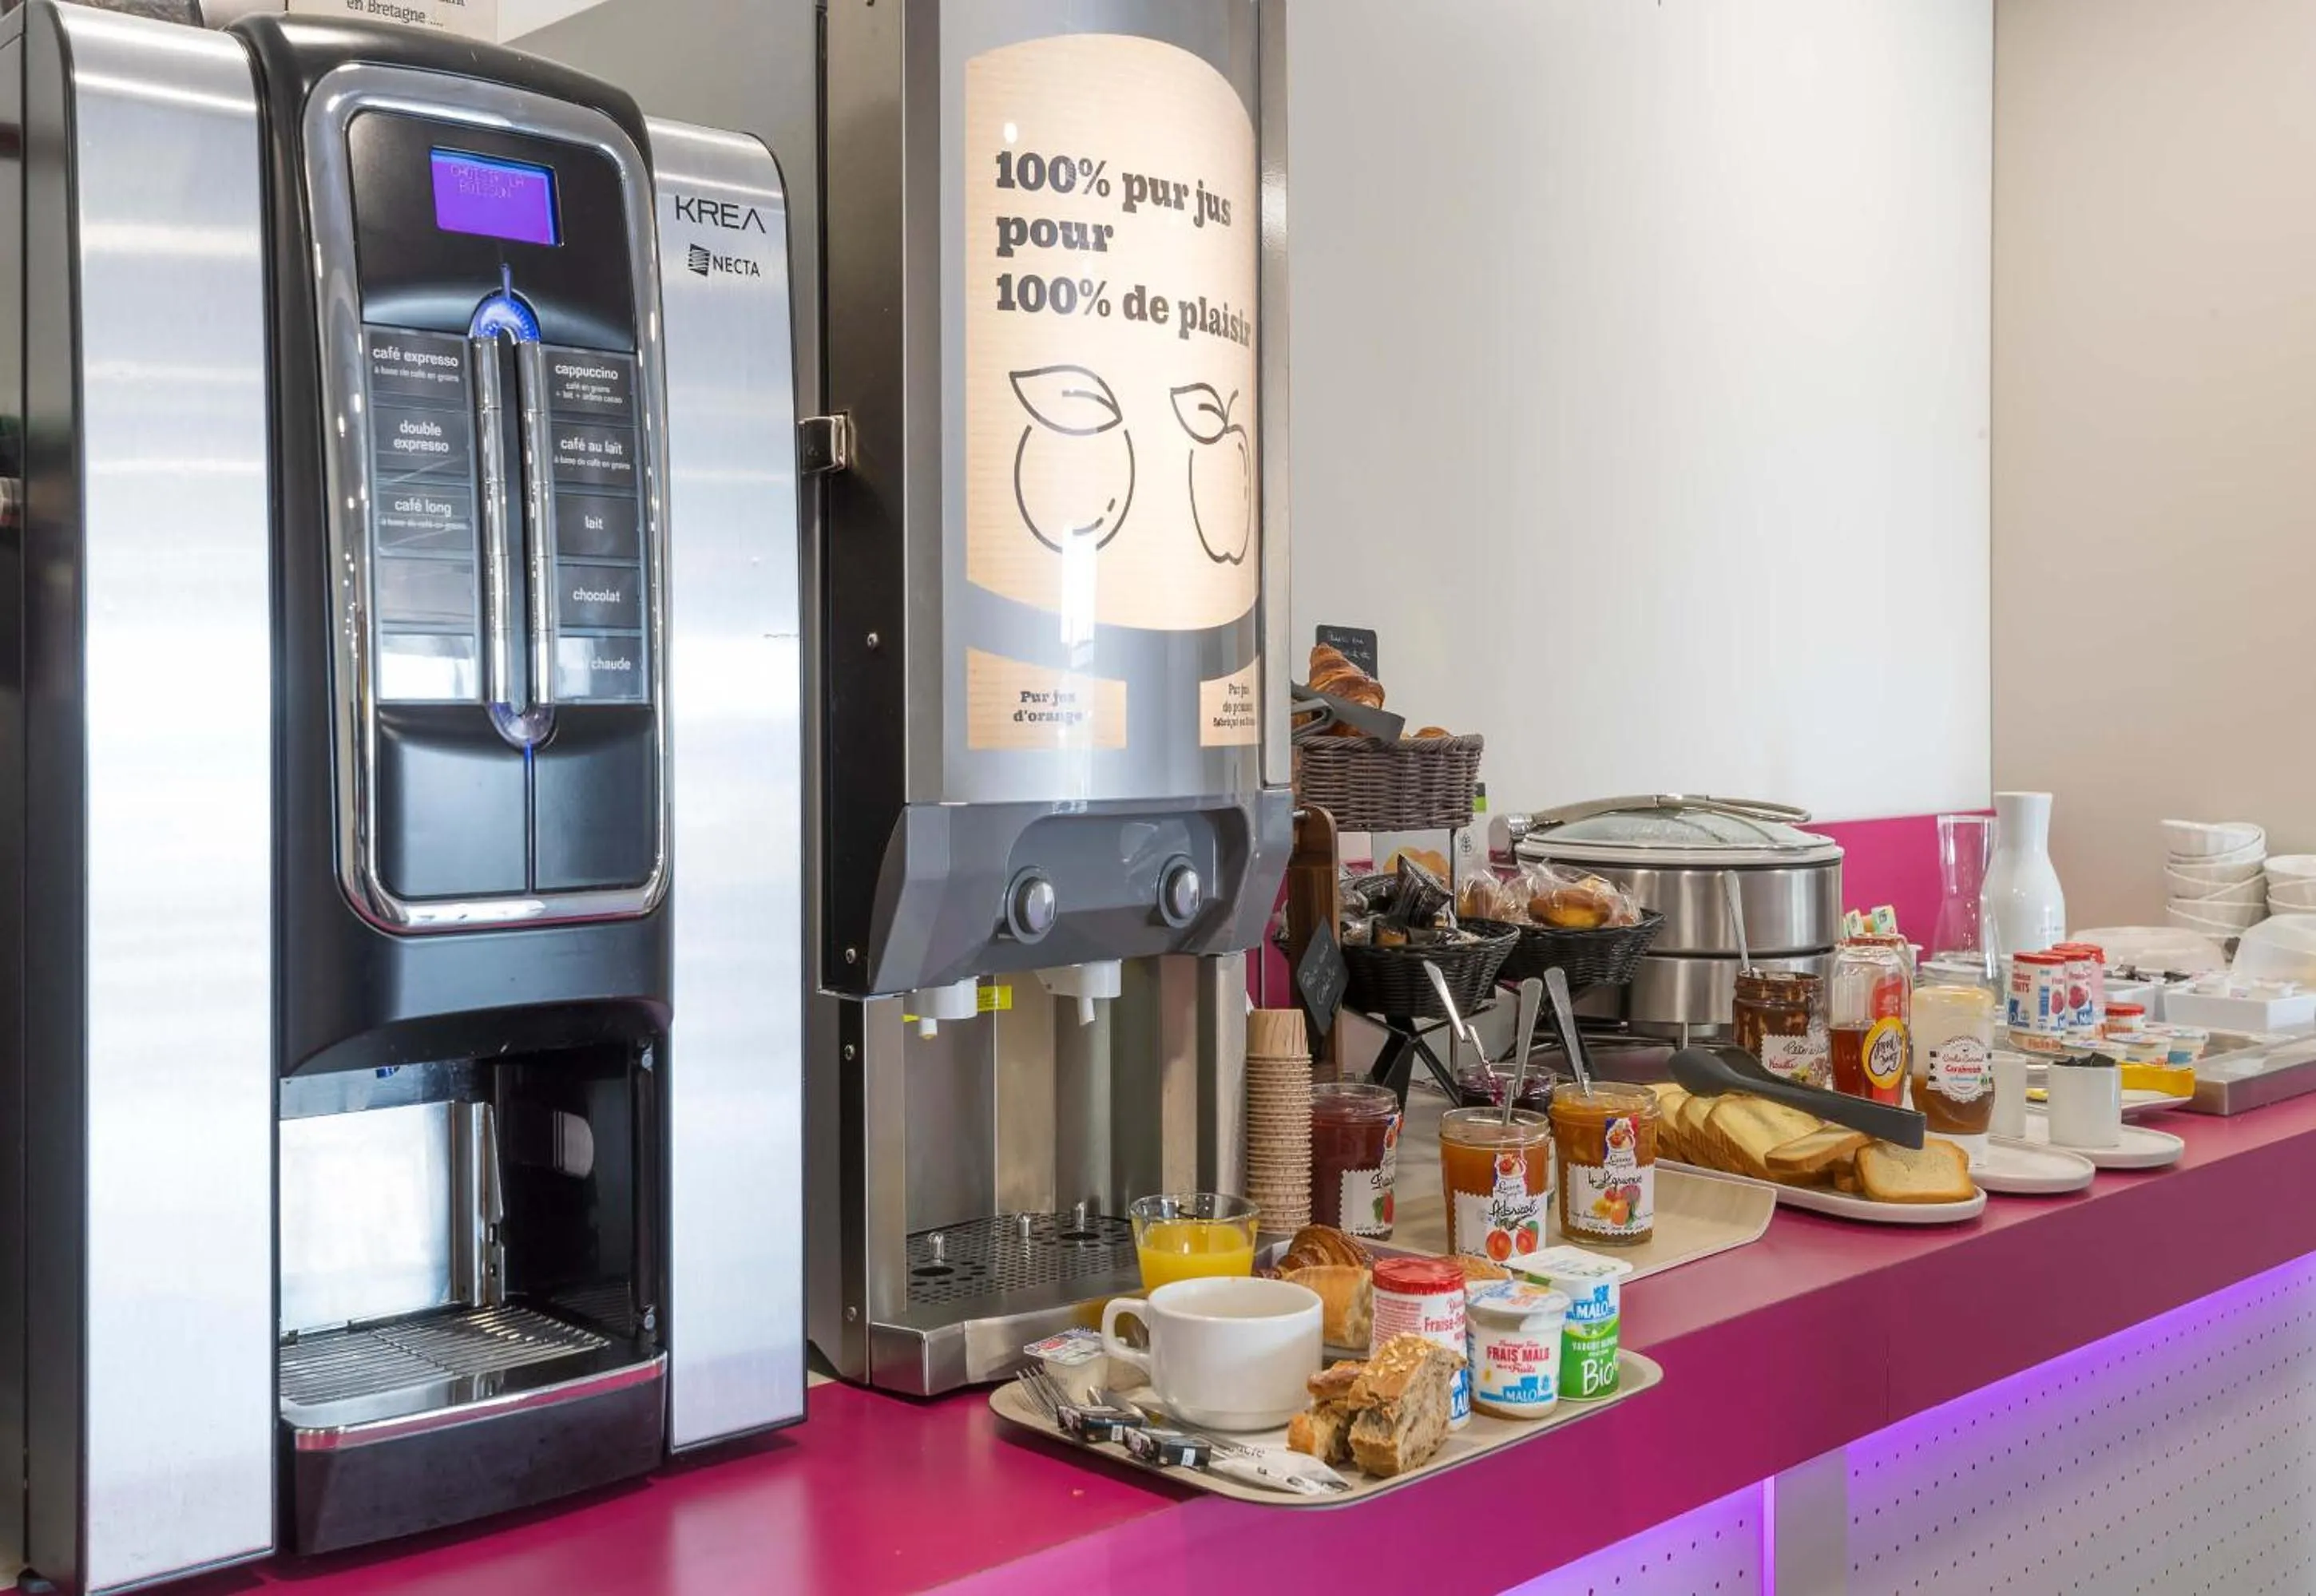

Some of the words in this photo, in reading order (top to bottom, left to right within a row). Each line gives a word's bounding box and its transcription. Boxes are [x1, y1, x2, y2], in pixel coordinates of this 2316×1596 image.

[367, 0, 425, 23] Bretagne
[995, 150, 1111, 198] 100%
[1121, 172, 1190, 214] pur
[1193, 179, 1231, 228] jus
[675, 194, 767, 234] KREA
[996, 216, 1114, 258] pour
[712, 255, 761, 278] NECTA
[996, 272, 1111, 318] 100%
[1123, 284, 1170, 325] de
[1178, 295, 1252, 348] plaisir
[373, 345, 400, 359] café
[403, 350, 459, 368] expresso
[555, 363, 619, 381] cappuccino
[399, 419, 442, 436] double
[393, 438, 450, 453] expresso
[561, 437, 586, 451] café
[588, 441, 602, 453] au
[605, 440, 623, 455] lait
[395, 497, 423, 512] café
[425, 499, 452, 519] long
[585, 514, 604, 531] lait
[572, 586, 621, 604] chocolat
[590, 656, 632, 671] chaude
[1020, 690, 1050, 703] Pur
[1012, 709, 1084, 726] d'orange
[1575, 1301, 1608, 1320] MALO
[1486, 1345, 1518, 1363] FRAIS
[1581, 1358, 1615, 1396] Bio
[1505, 1388, 1537, 1403] MALO
